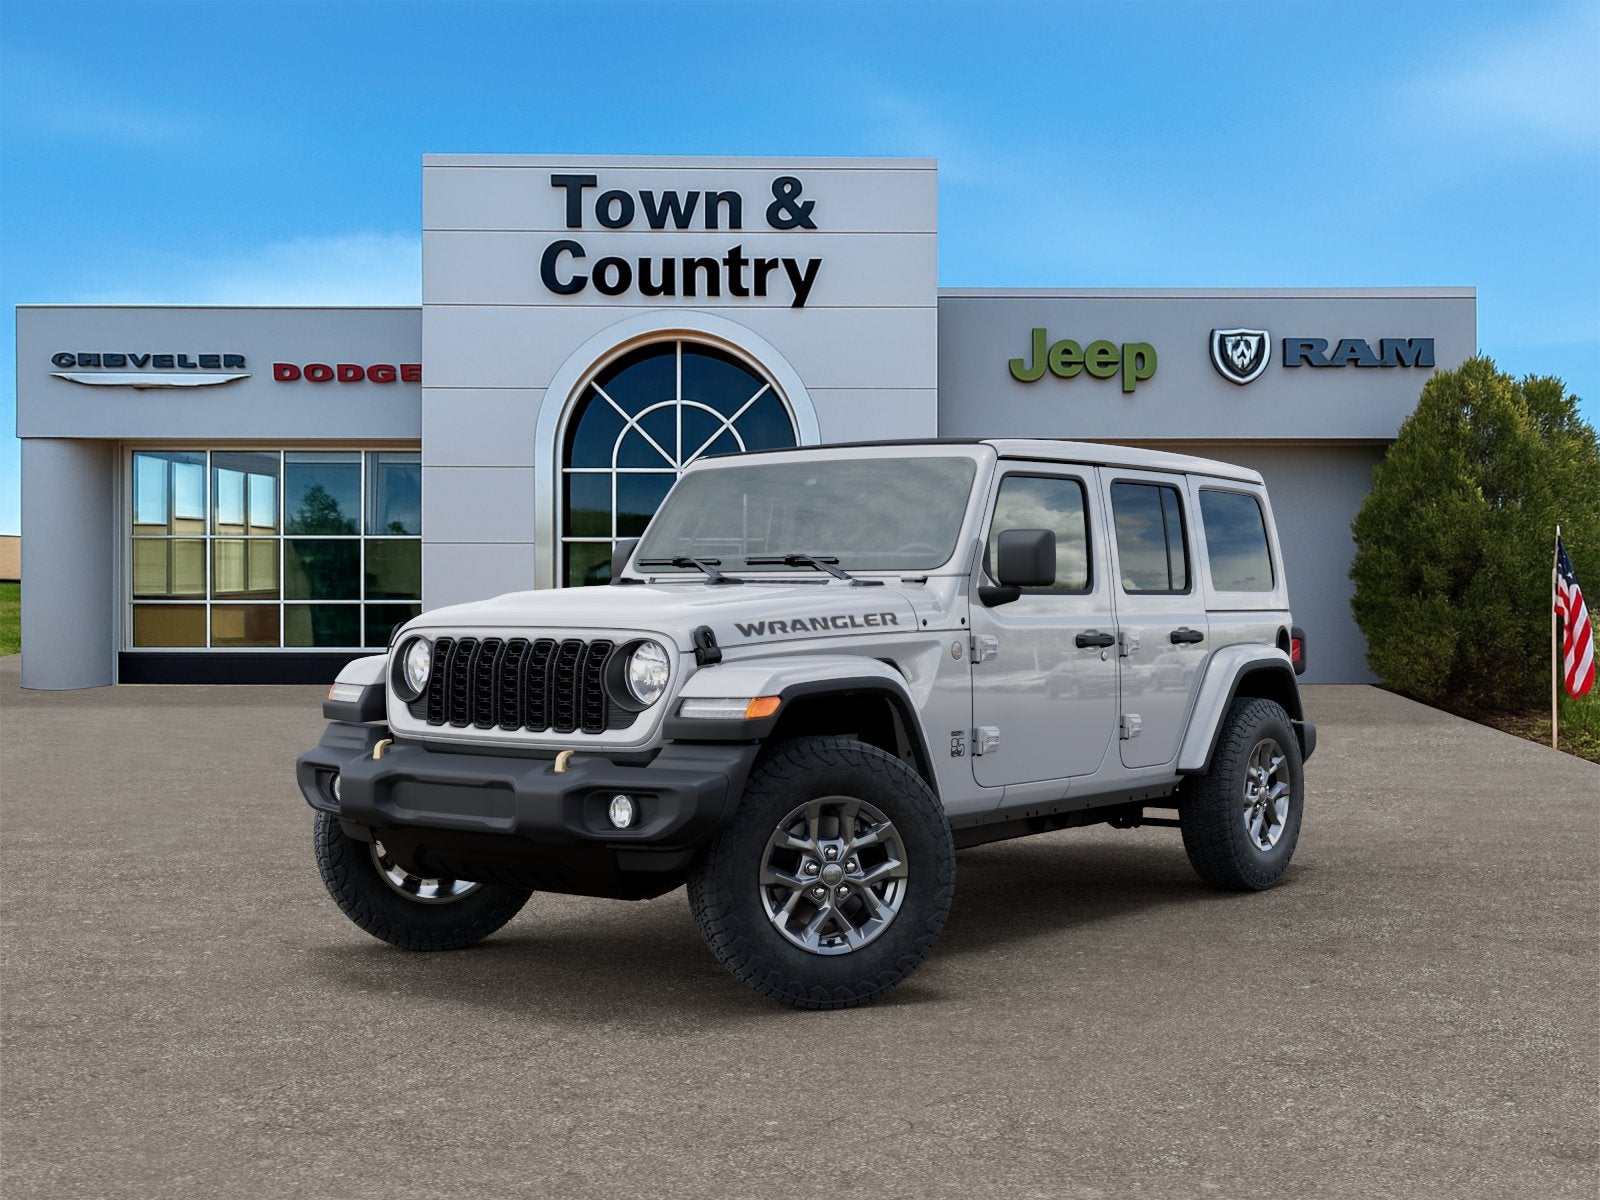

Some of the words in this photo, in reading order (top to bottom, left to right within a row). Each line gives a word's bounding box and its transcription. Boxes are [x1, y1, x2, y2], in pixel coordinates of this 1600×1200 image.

[551, 174, 742, 229] Town
[766, 176, 818, 229] &
[540, 240, 823, 308] Country
[273, 363, 422, 383] DODGE
[1008, 328, 1158, 393] Jeep
[1282, 338, 1435, 367] RAM
[734, 612, 899, 638] WRANGLER
